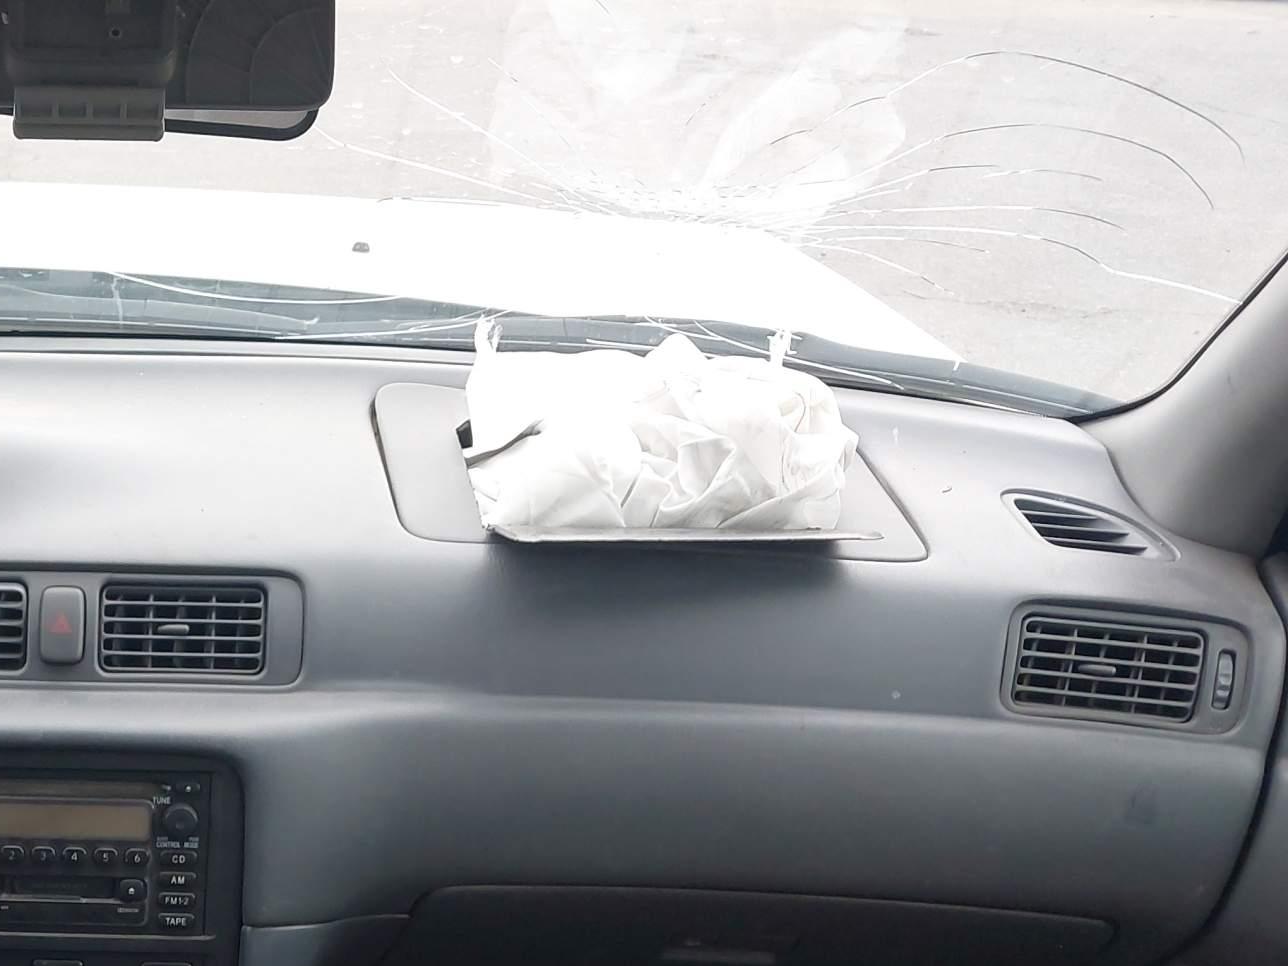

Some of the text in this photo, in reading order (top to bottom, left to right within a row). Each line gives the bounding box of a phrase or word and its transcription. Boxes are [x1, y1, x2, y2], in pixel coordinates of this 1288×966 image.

[152, 796, 171, 805] TUNE
[70, 852, 78, 862] 4
[102, 852, 109, 862] 5
[133, 854, 141, 864] 6
[171, 854, 186, 864] CD
[170, 875, 185, 885] AM
[165, 917, 187, 926] TAPE
